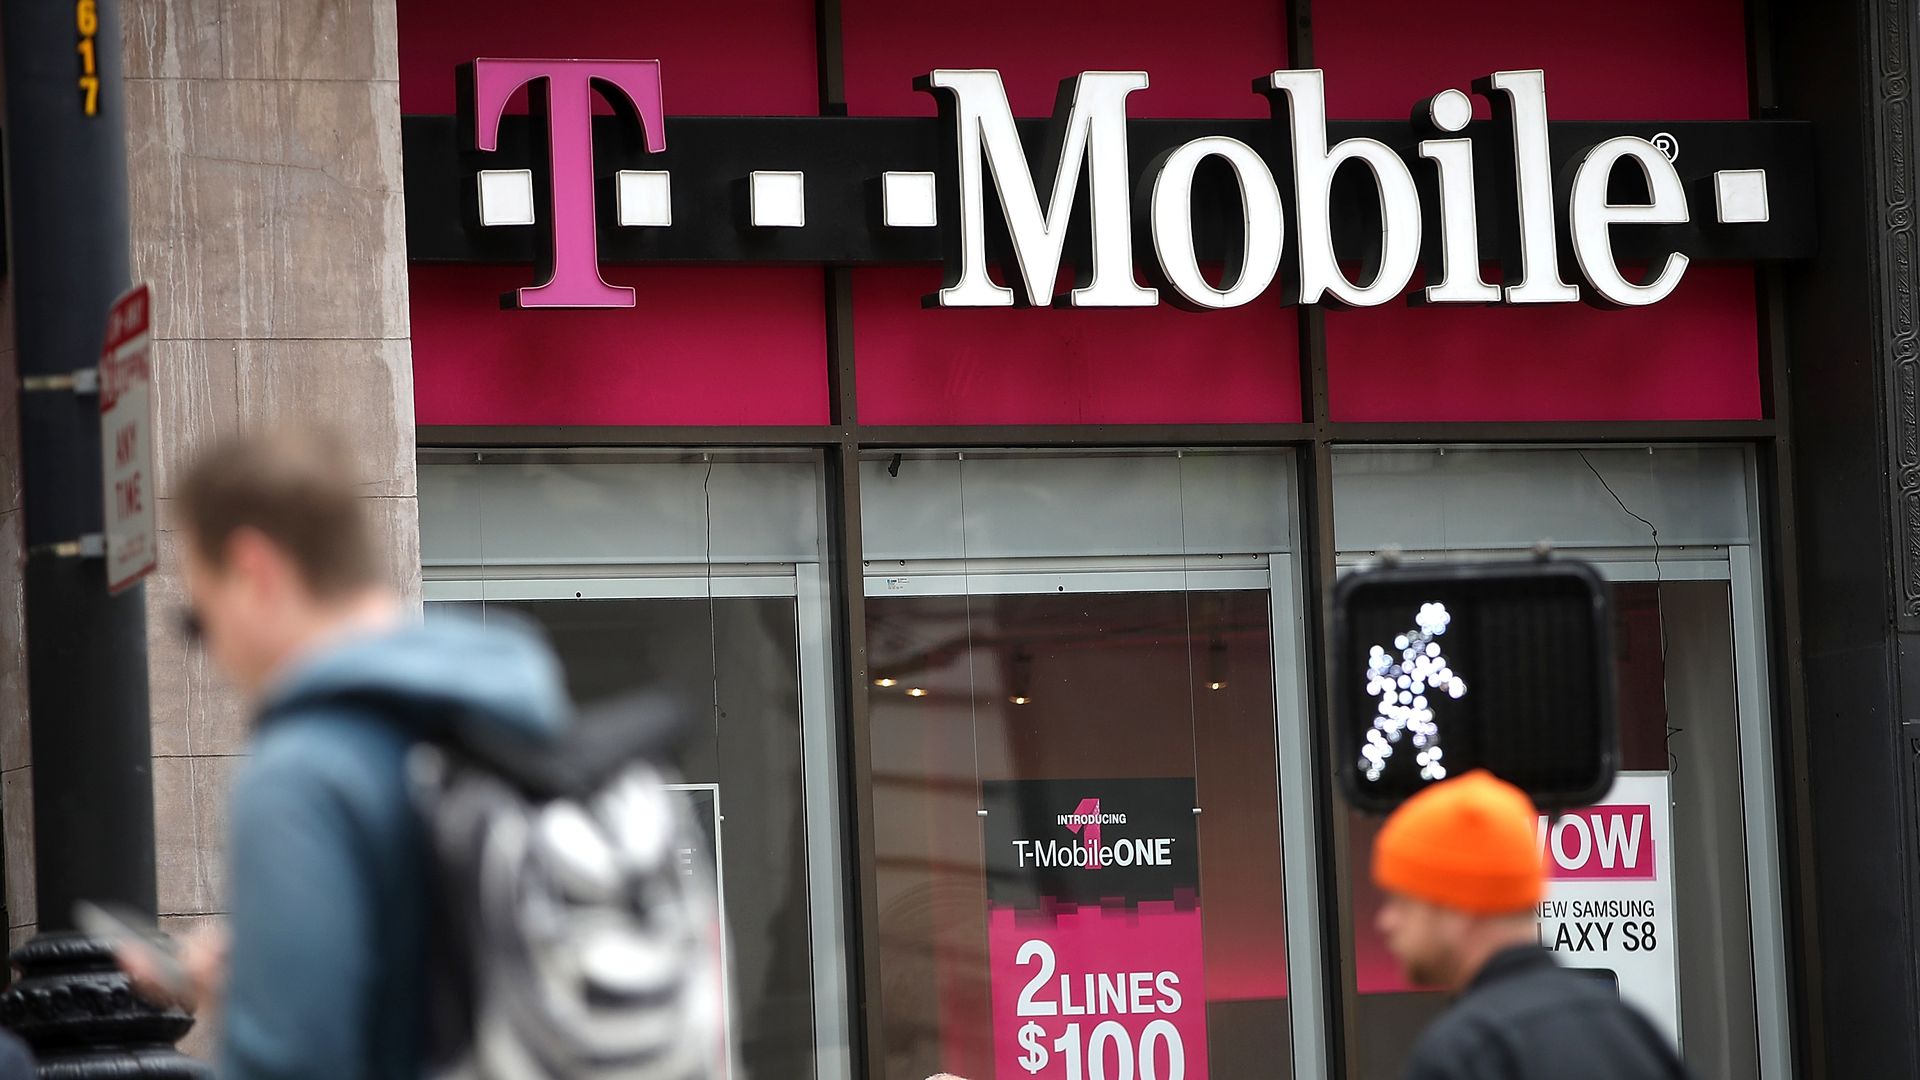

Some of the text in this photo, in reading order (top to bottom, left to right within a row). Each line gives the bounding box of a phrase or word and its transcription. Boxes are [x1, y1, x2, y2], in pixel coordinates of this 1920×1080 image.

[76, 0, 98, 117] 617
[1057, 813, 1127, 826] INTRODUCING
[1572, 900, 1655, 918] SAMSUNG
[1536, 921, 1657, 952] LAXY S8
[1015, 939, 1183, 1017] 2 LINES
